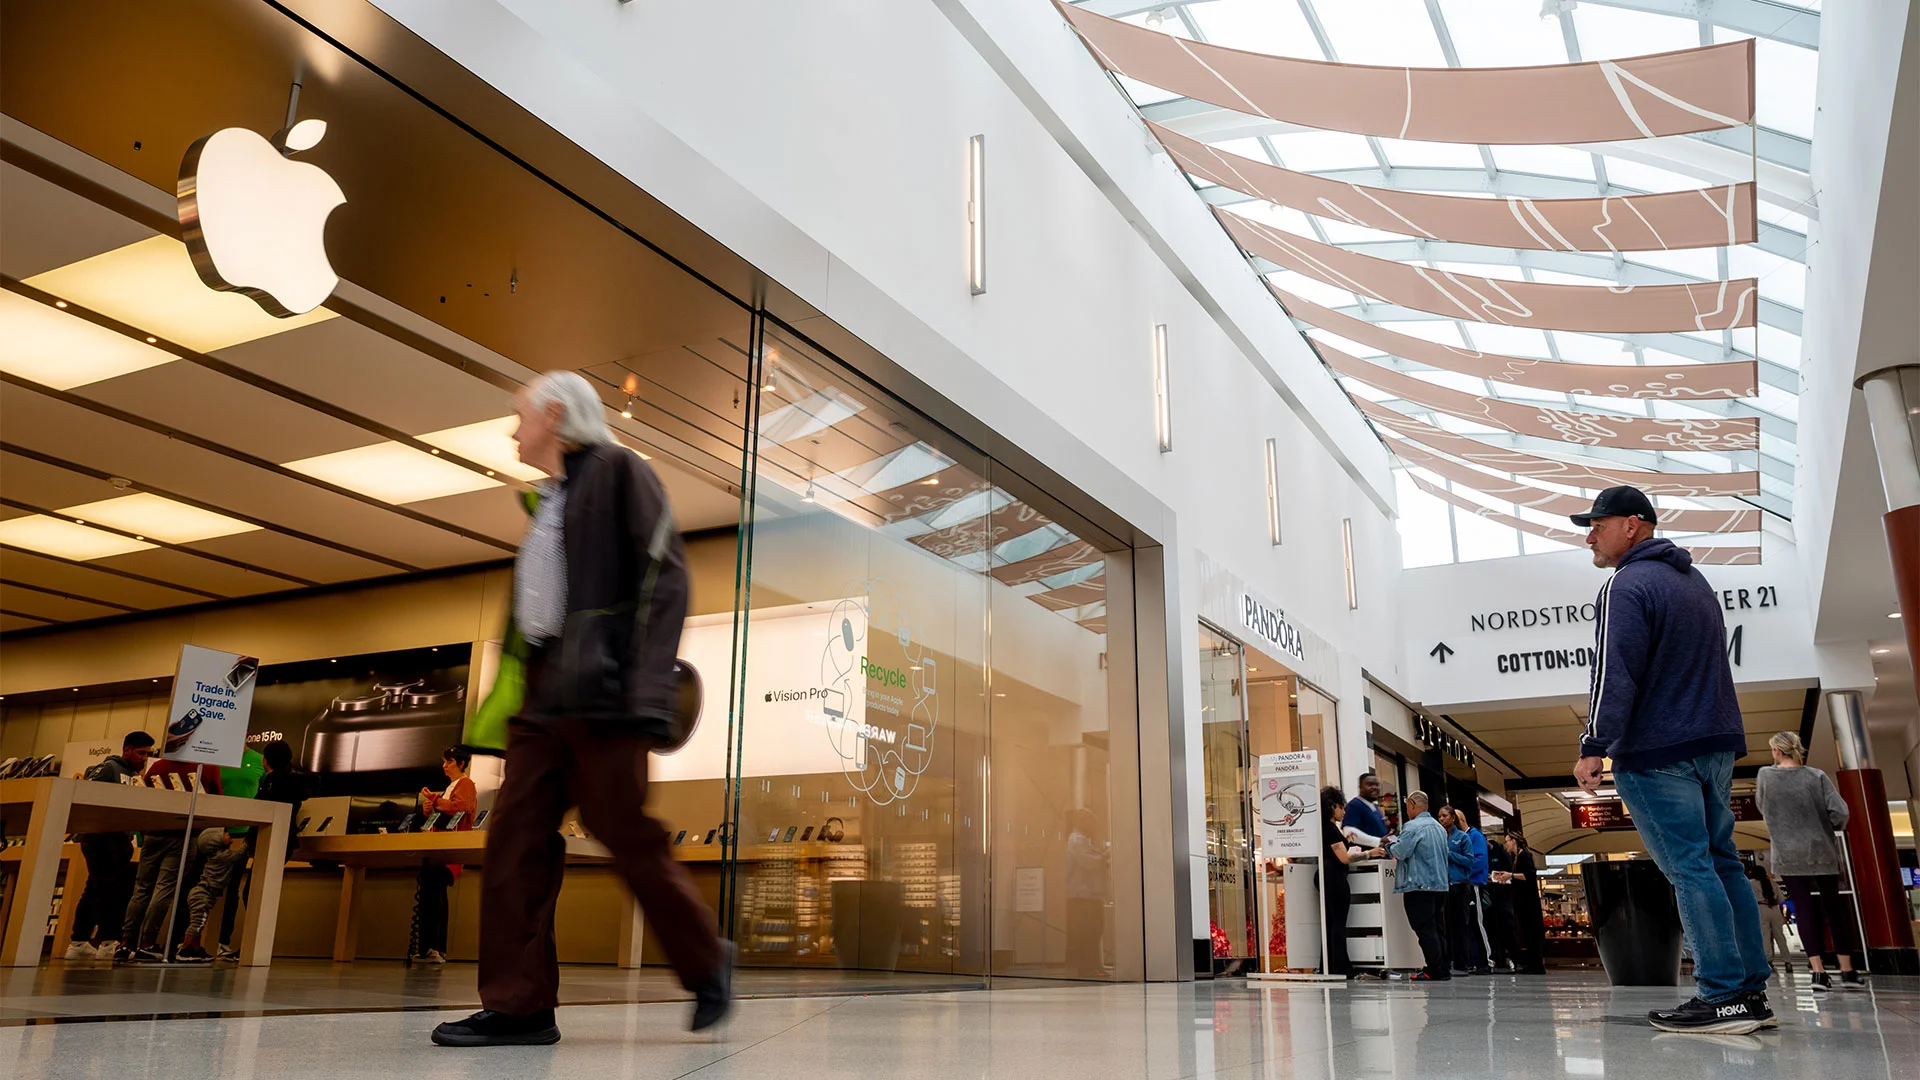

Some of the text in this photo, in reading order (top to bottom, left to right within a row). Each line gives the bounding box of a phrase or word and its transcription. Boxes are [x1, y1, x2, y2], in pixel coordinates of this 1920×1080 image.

[1757, 586, 1777, 608] 21
[1471, 603, 1597, 632] NORDSTRO
[1243, 593, 1304, 661] PANDORA
[861, 656, 907, 689] Recycle
[196, 681, 237, 698] Trade in.
[773, 687, 829, 702] Vision Pro
[191, 693, 237, 711] Upgrade.
[199, 707, 226, 721] Save.
[247, 730, 283, 743] one 15 Pro
[88, 746, 112, 757] MagSafe
[1278, 753, 1306, 761] PANDORA
[1209, 870, 1237, 884] DIAMONDS
[1716, 1003, 1748, 1018] HOKA
